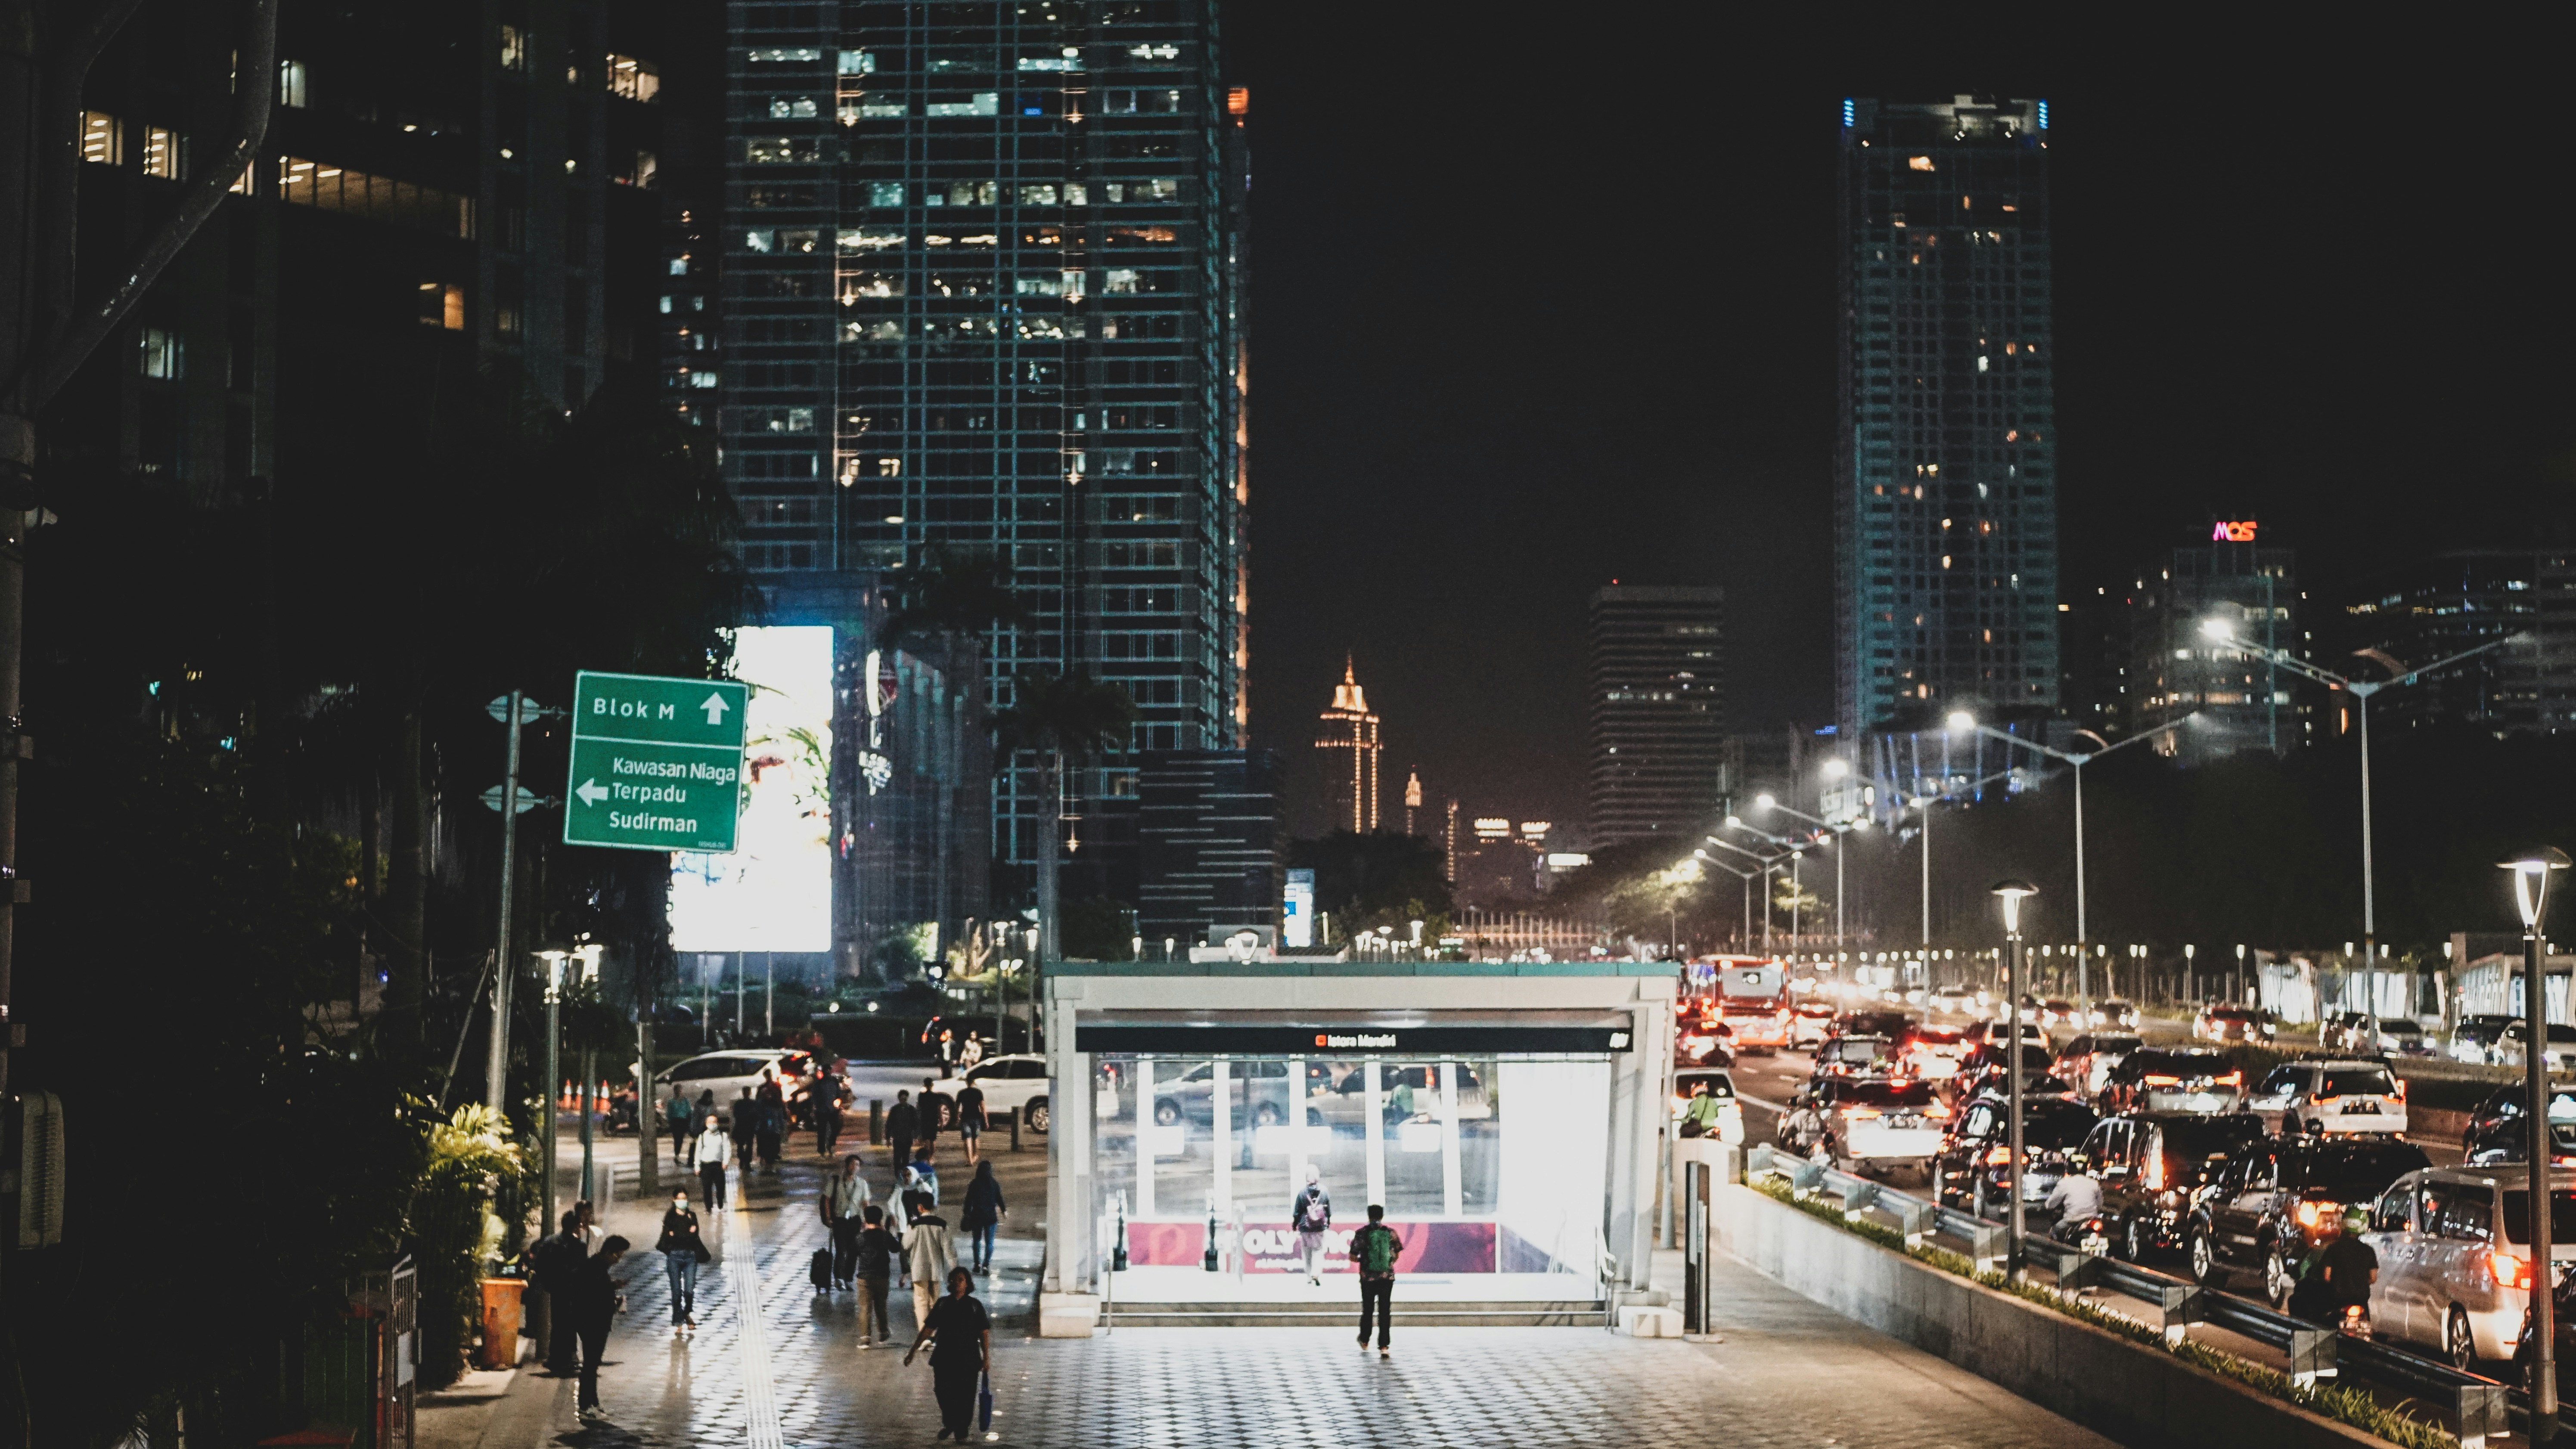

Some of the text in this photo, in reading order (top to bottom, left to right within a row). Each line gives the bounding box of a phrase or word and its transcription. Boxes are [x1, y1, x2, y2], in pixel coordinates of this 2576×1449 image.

[594, 697, 674, 720] Blok M
[613, 757, 736, 786] Kawasan Niaga
[612, 782, 686, 804] Terpadu
[609, 811, 697, 833] Sudirman
[1328, 1034, 1396, 1047] Istora Mandiri
